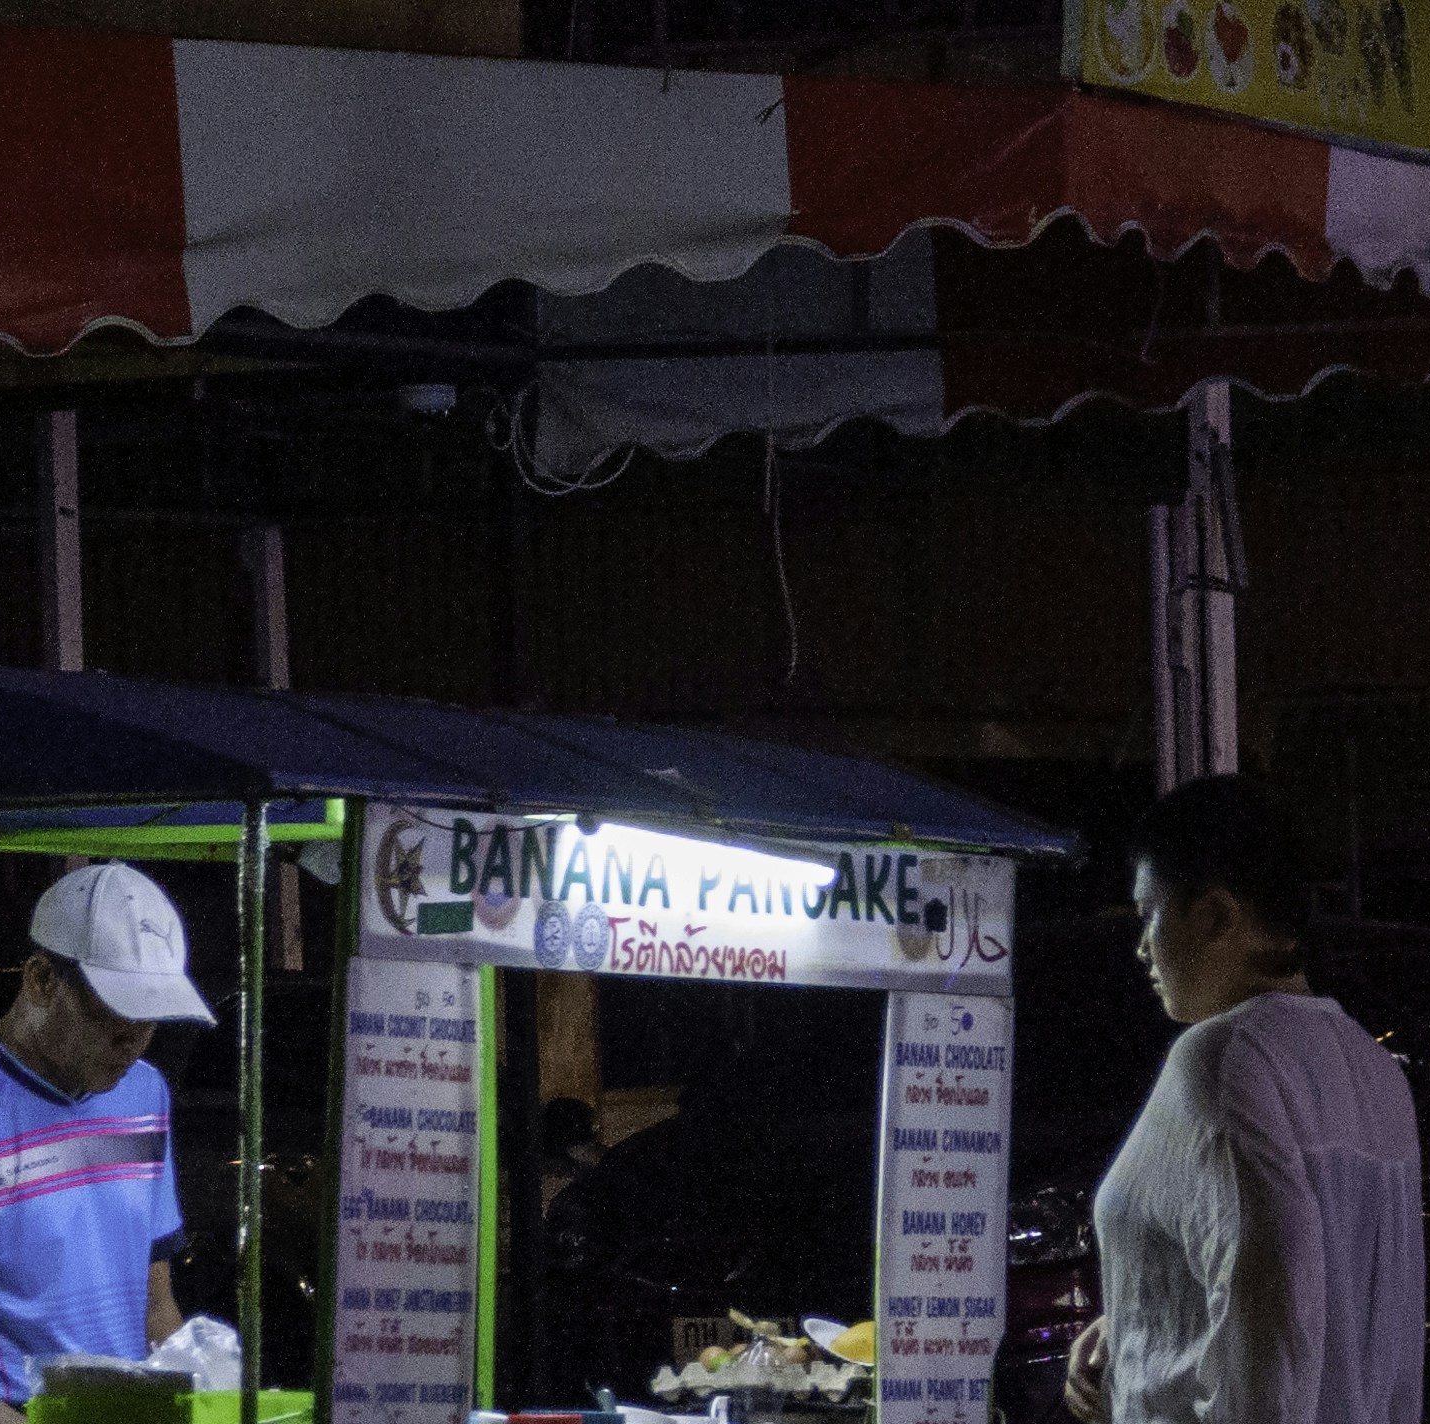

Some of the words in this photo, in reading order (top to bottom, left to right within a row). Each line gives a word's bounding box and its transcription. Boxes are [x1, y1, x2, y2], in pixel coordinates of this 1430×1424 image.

[448, 817, 671, 912] BANANA
[698, 848, 922, 927] PANCAKE
[607, 915, 787, 981] โรตีกล้วยหอม
[350, 1011, 385, 1036] BANANA
[896, 1042, 940, 1067] BANANA
[945, 1044, 1005, 1071] CHOCOLATE
[371, 1105, 412, 1129] BANANA
[417, 1108, 476, 1134] CHOCOLATE
[893, 1128, 938, 1151] BANANA
[942, 1129, 1001, 1154] CINNAMON
[367, 1196, 410, 1221] BANANA
[415, 1199, 474, 1224] CHOCOLATE
[902, 1210, 946, 1235] BANANA
[951, 1212, 987, 1236] HONEY
[888, 1297, 922, 1317] HONEY
[926, 1297, 960, 1317] LEMON
[965, 1297, 996, 1318] SUGAR
[882, 1378, 922, 1401] BANANA
[927, 1378, 964, 1401] PEANUT
